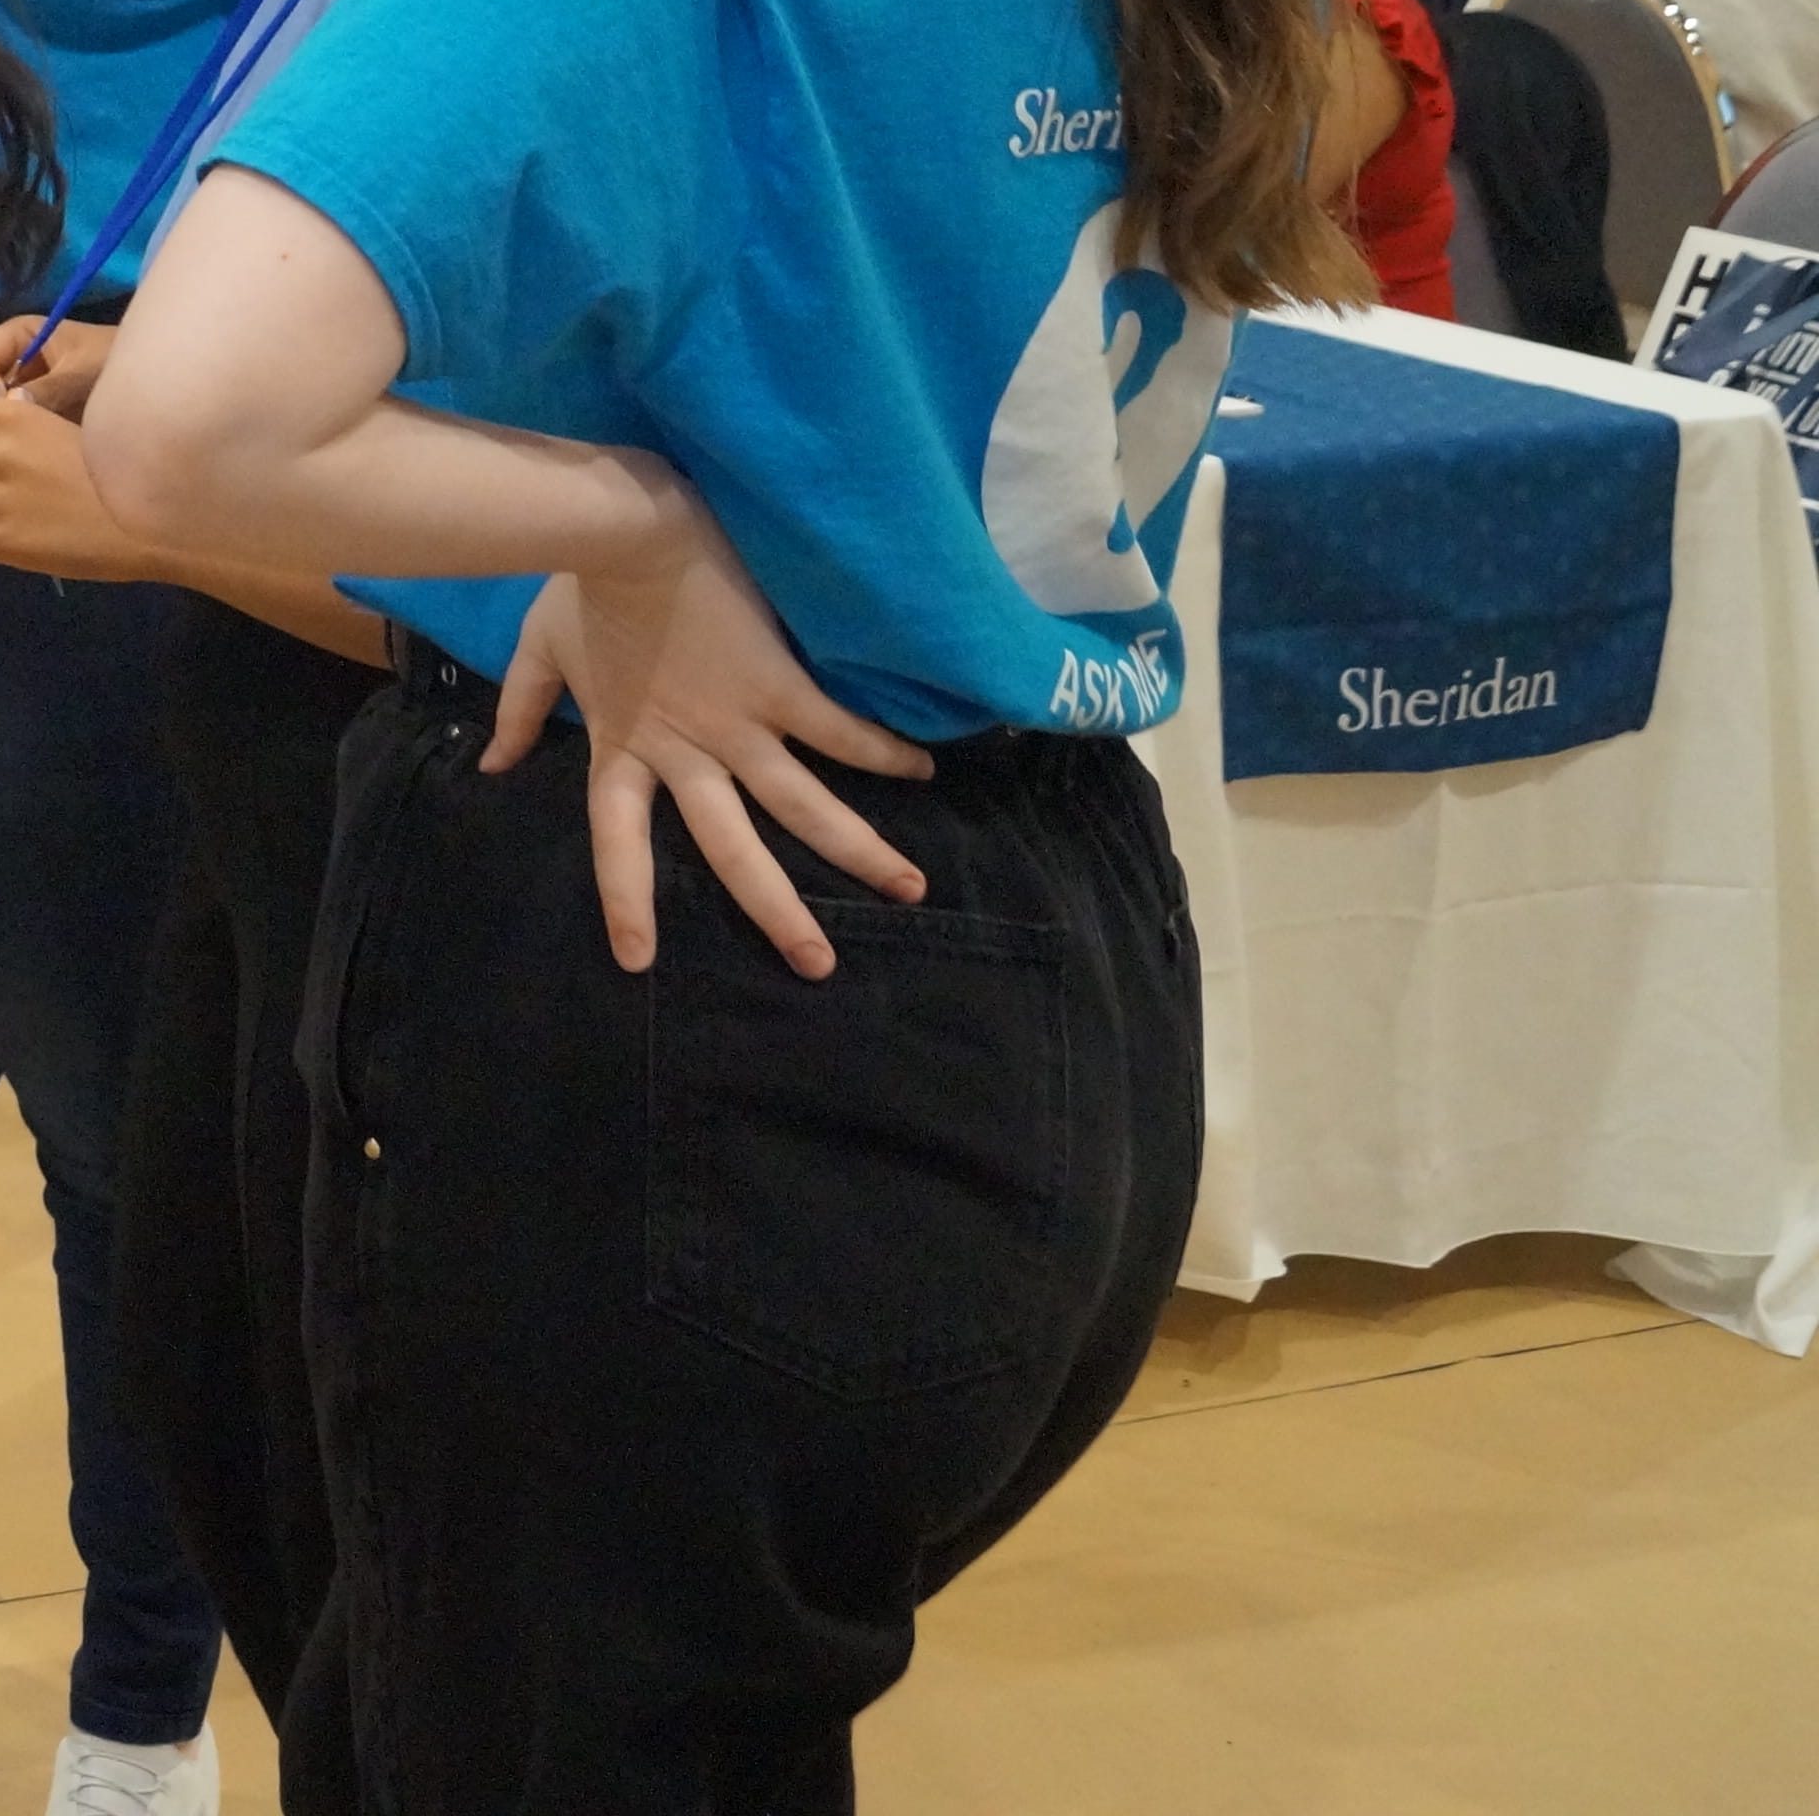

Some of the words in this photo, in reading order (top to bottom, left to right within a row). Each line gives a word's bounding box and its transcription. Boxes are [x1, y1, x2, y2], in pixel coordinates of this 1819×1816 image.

[1008, 87, 1123, 159] Sheri
[1049, 647, 1126, 730] ASK
[1116, 628, 1169, 726] ME
[1336, 656, 1559, 734] Sheridan
